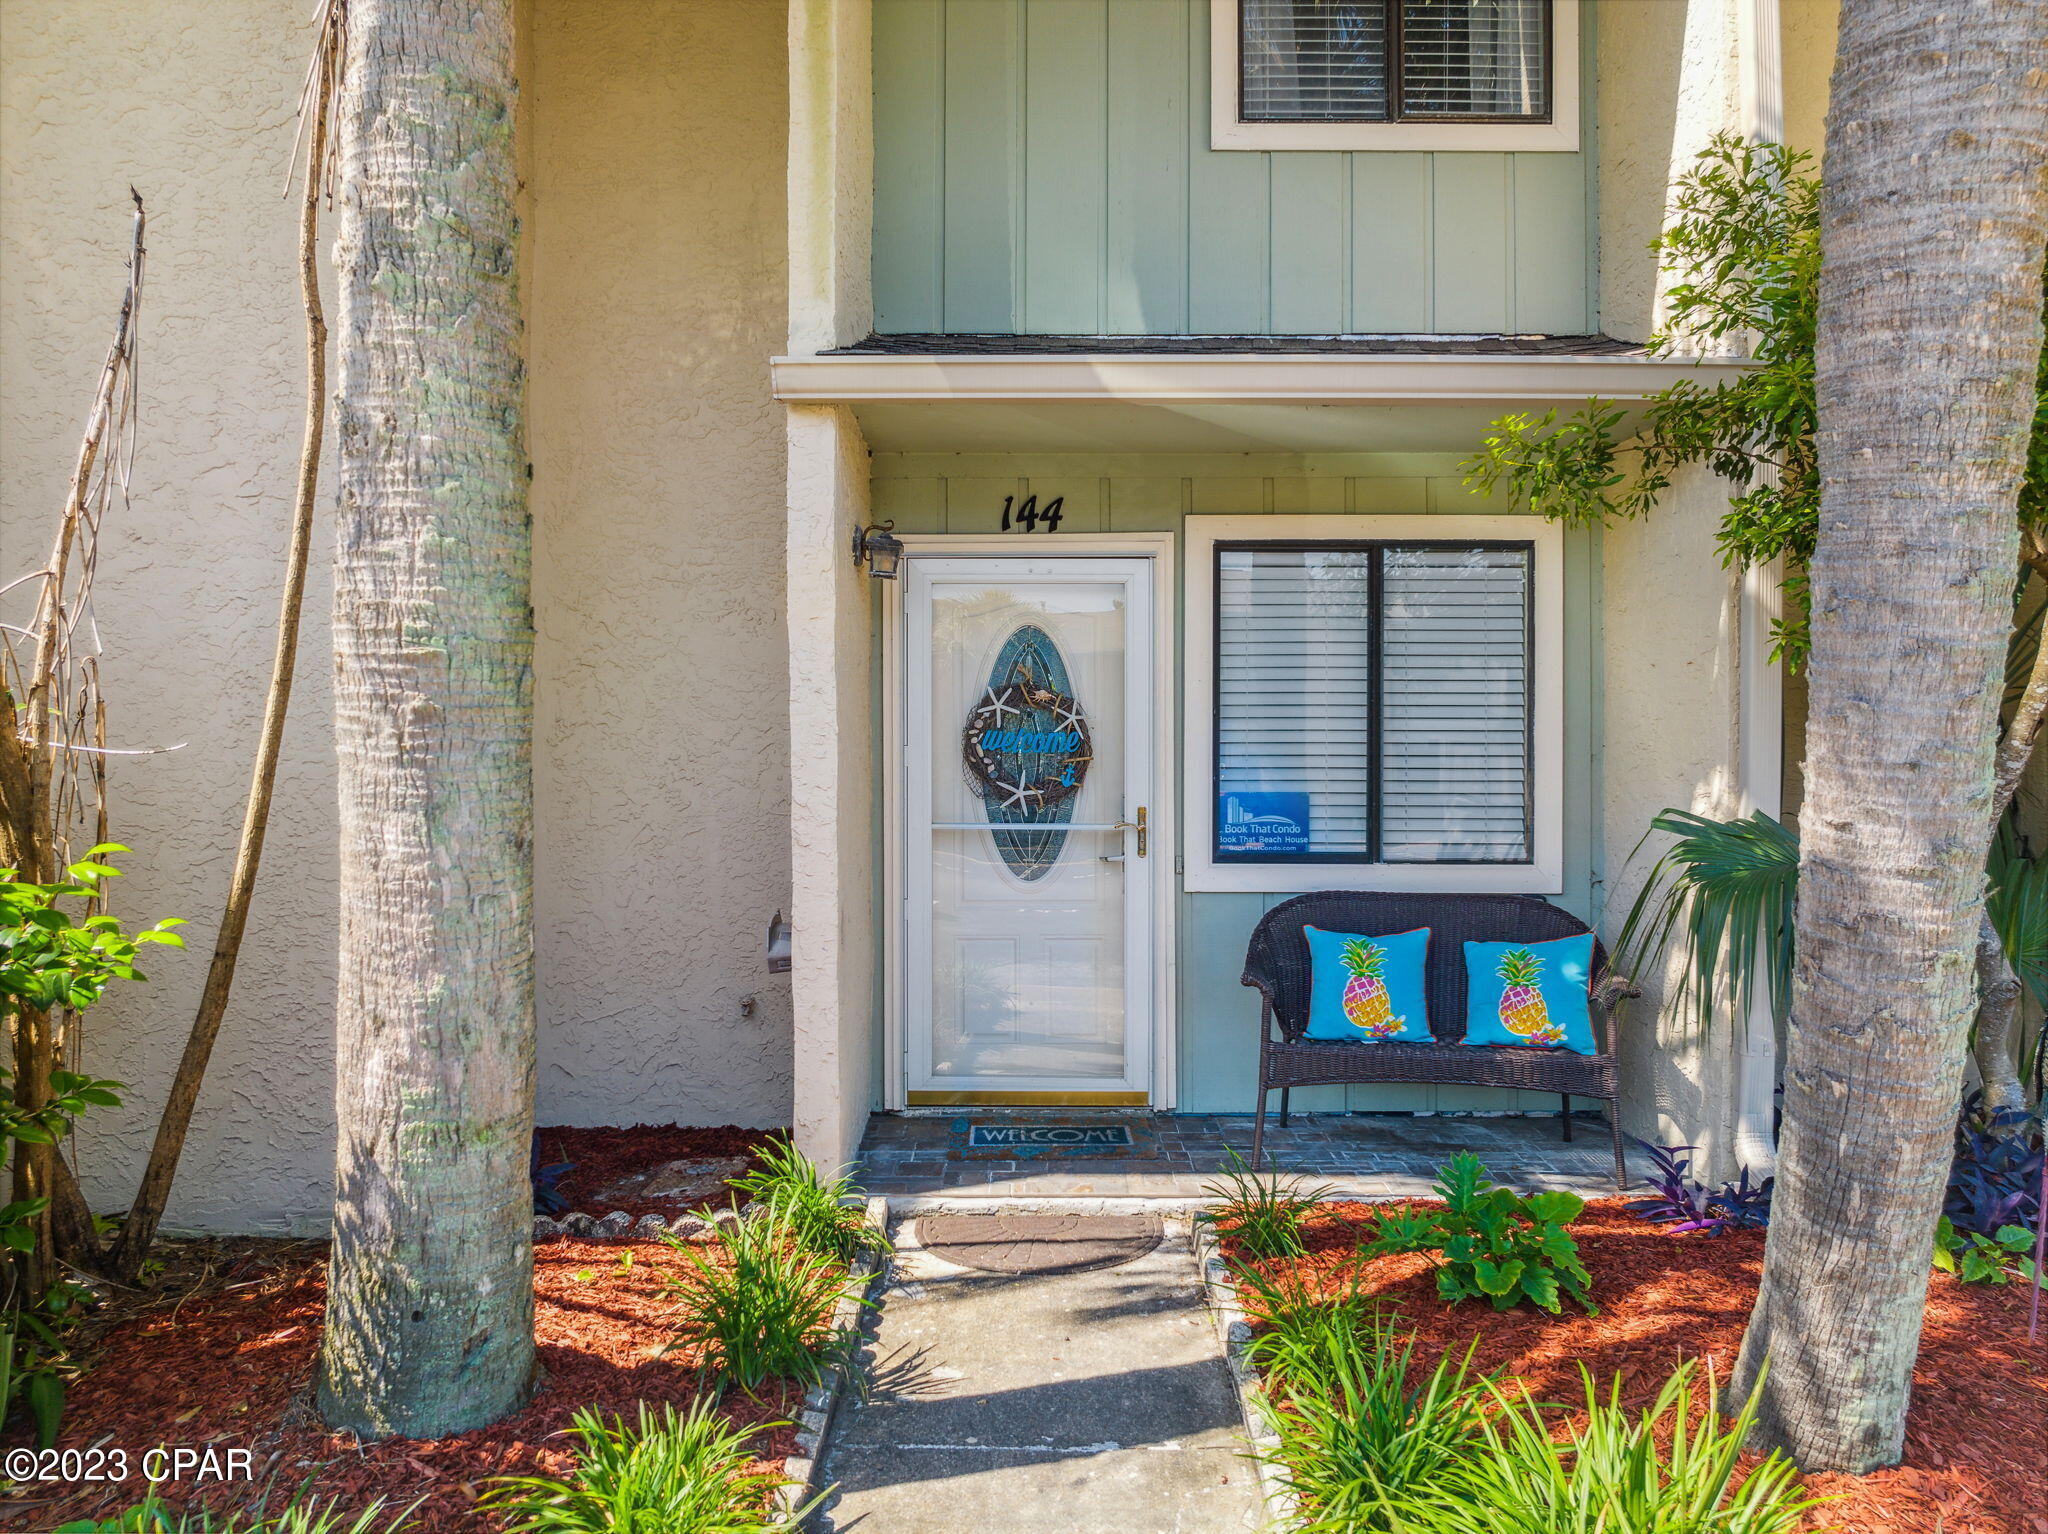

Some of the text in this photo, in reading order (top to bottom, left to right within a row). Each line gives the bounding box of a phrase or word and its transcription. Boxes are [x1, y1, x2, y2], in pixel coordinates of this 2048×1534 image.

[1001, 495, 1064, 533] 144
[981, 727, 1081, 753] welcome
[1225, 824, 1301, 834] Book That Condo
[982, 1129, 1121, 1142] WELCOME
